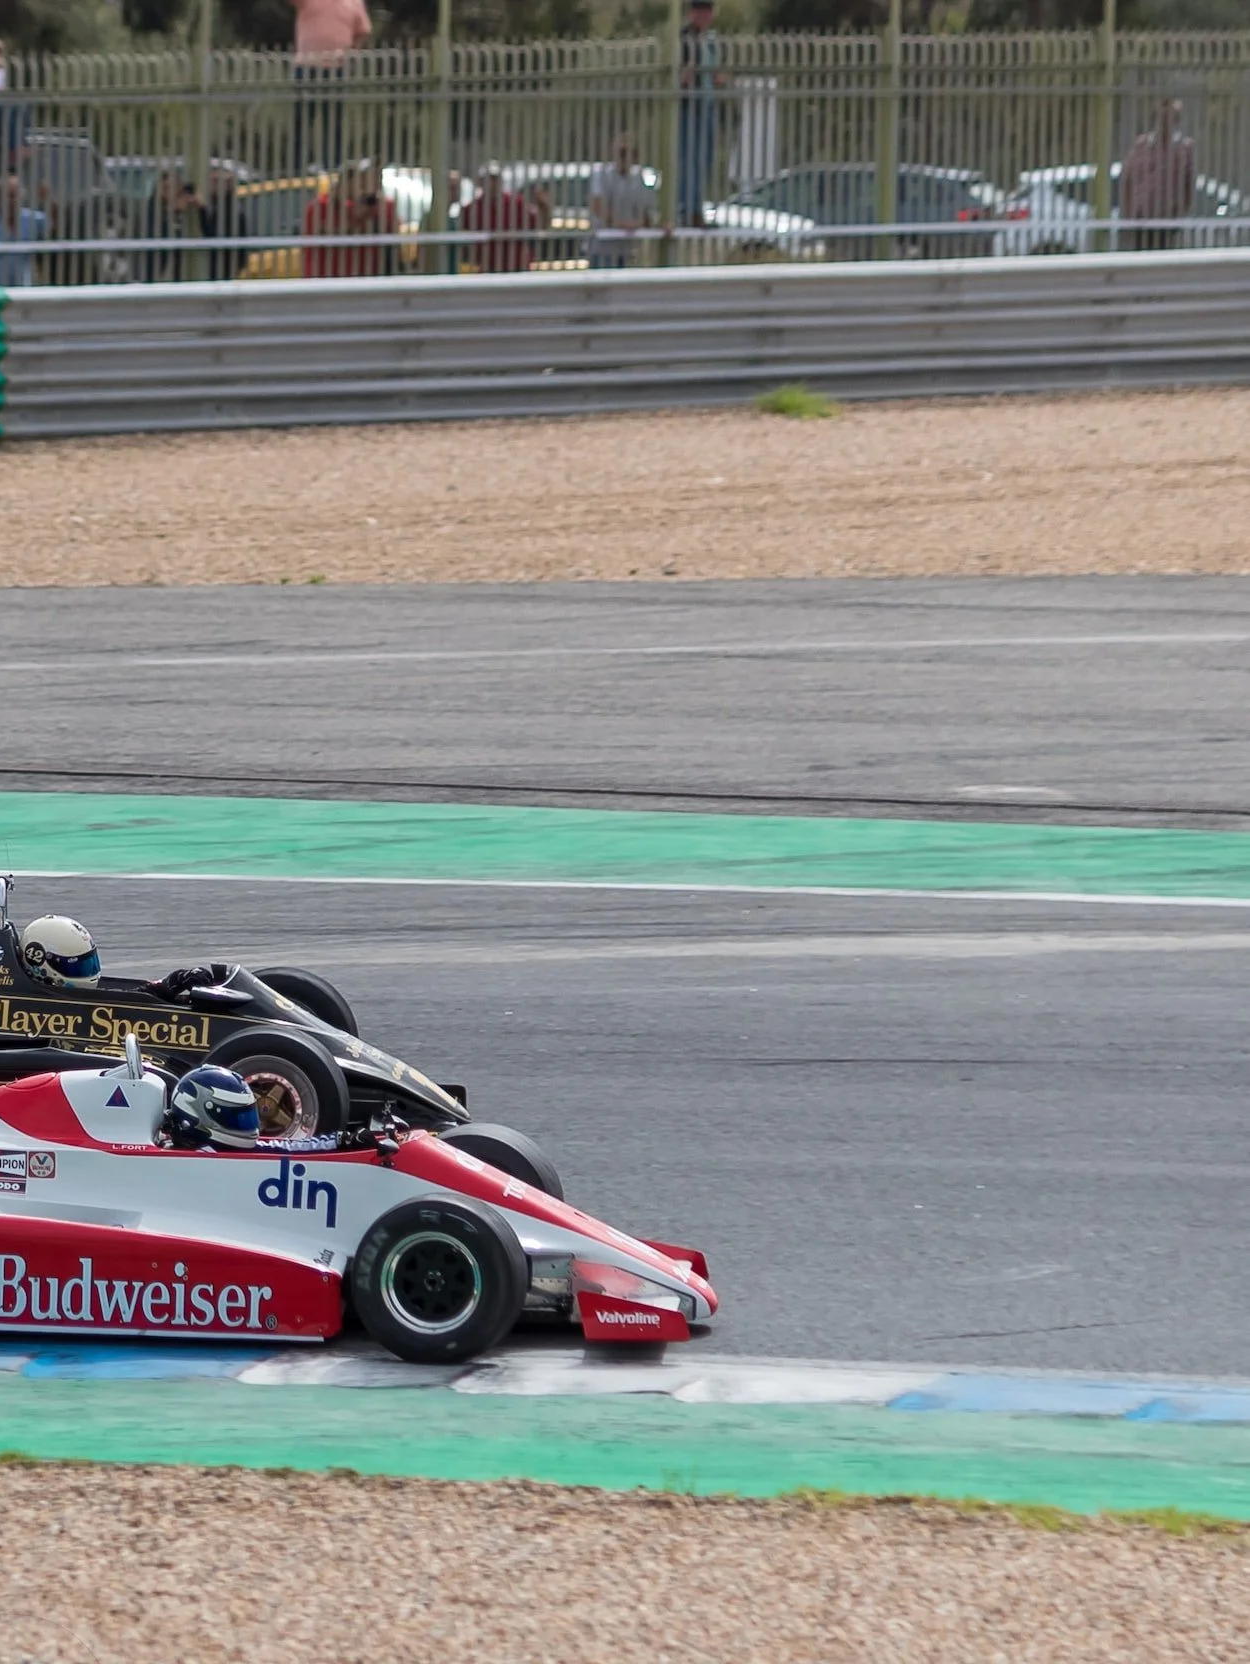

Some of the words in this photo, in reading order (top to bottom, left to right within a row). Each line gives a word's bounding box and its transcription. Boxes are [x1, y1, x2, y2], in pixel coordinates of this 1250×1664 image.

[25, 947, 44, 963] 42
[89, 1006, 211, 1048] Special
[594, 1309, 661, 1326] Valvoline
